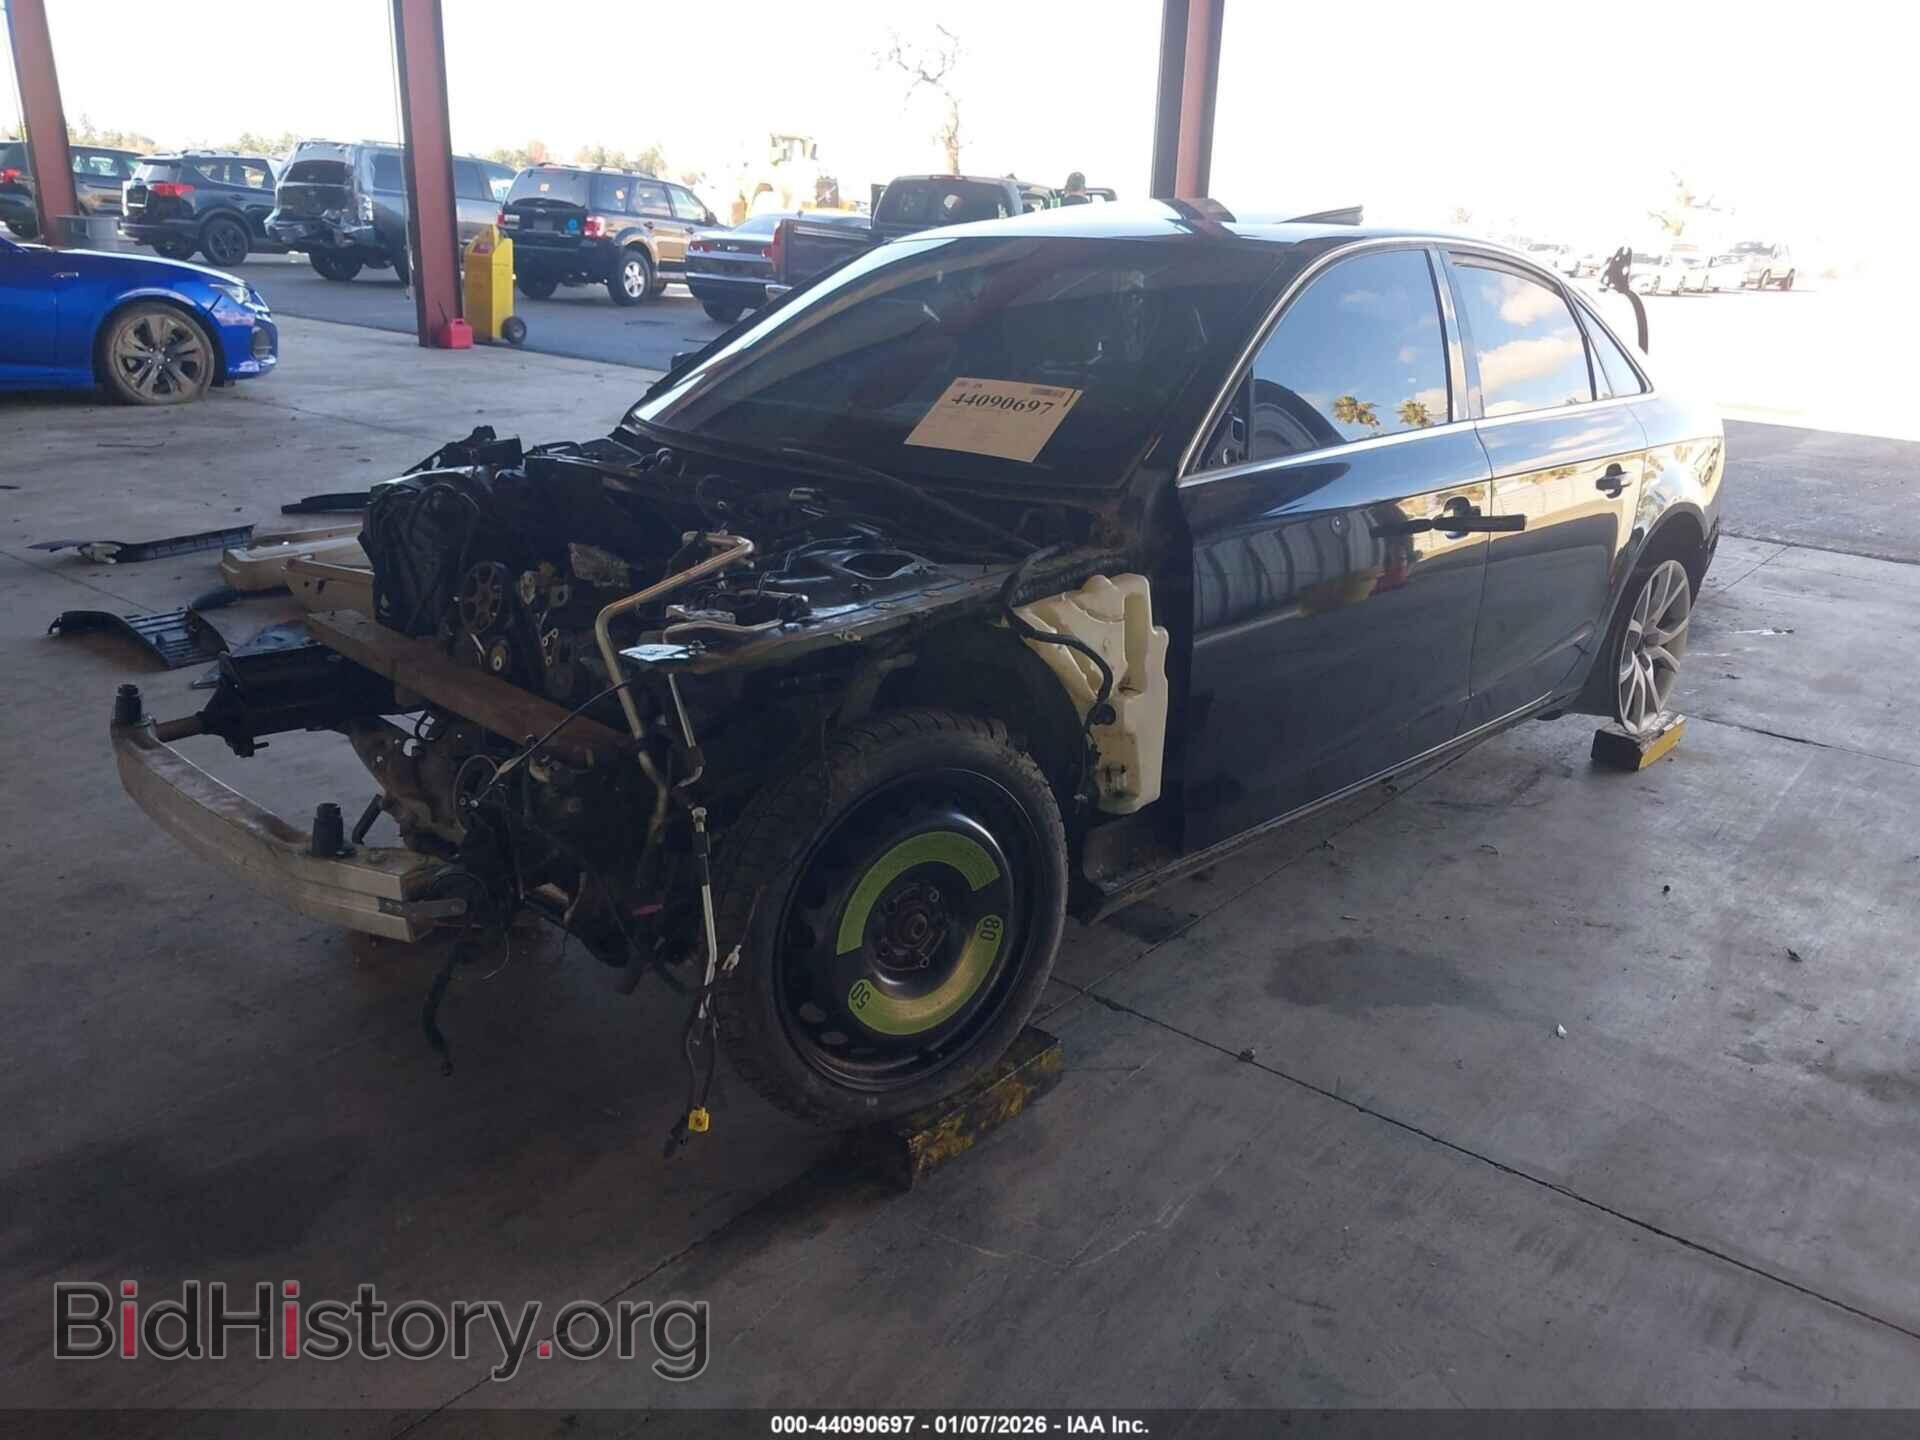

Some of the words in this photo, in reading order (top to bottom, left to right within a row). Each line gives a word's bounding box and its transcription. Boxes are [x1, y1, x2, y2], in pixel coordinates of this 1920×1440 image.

[951, 392, 1054, 416] 44090697
[980, 918, 1001, 942] 80
[850, 982, 871, 1009] 50
